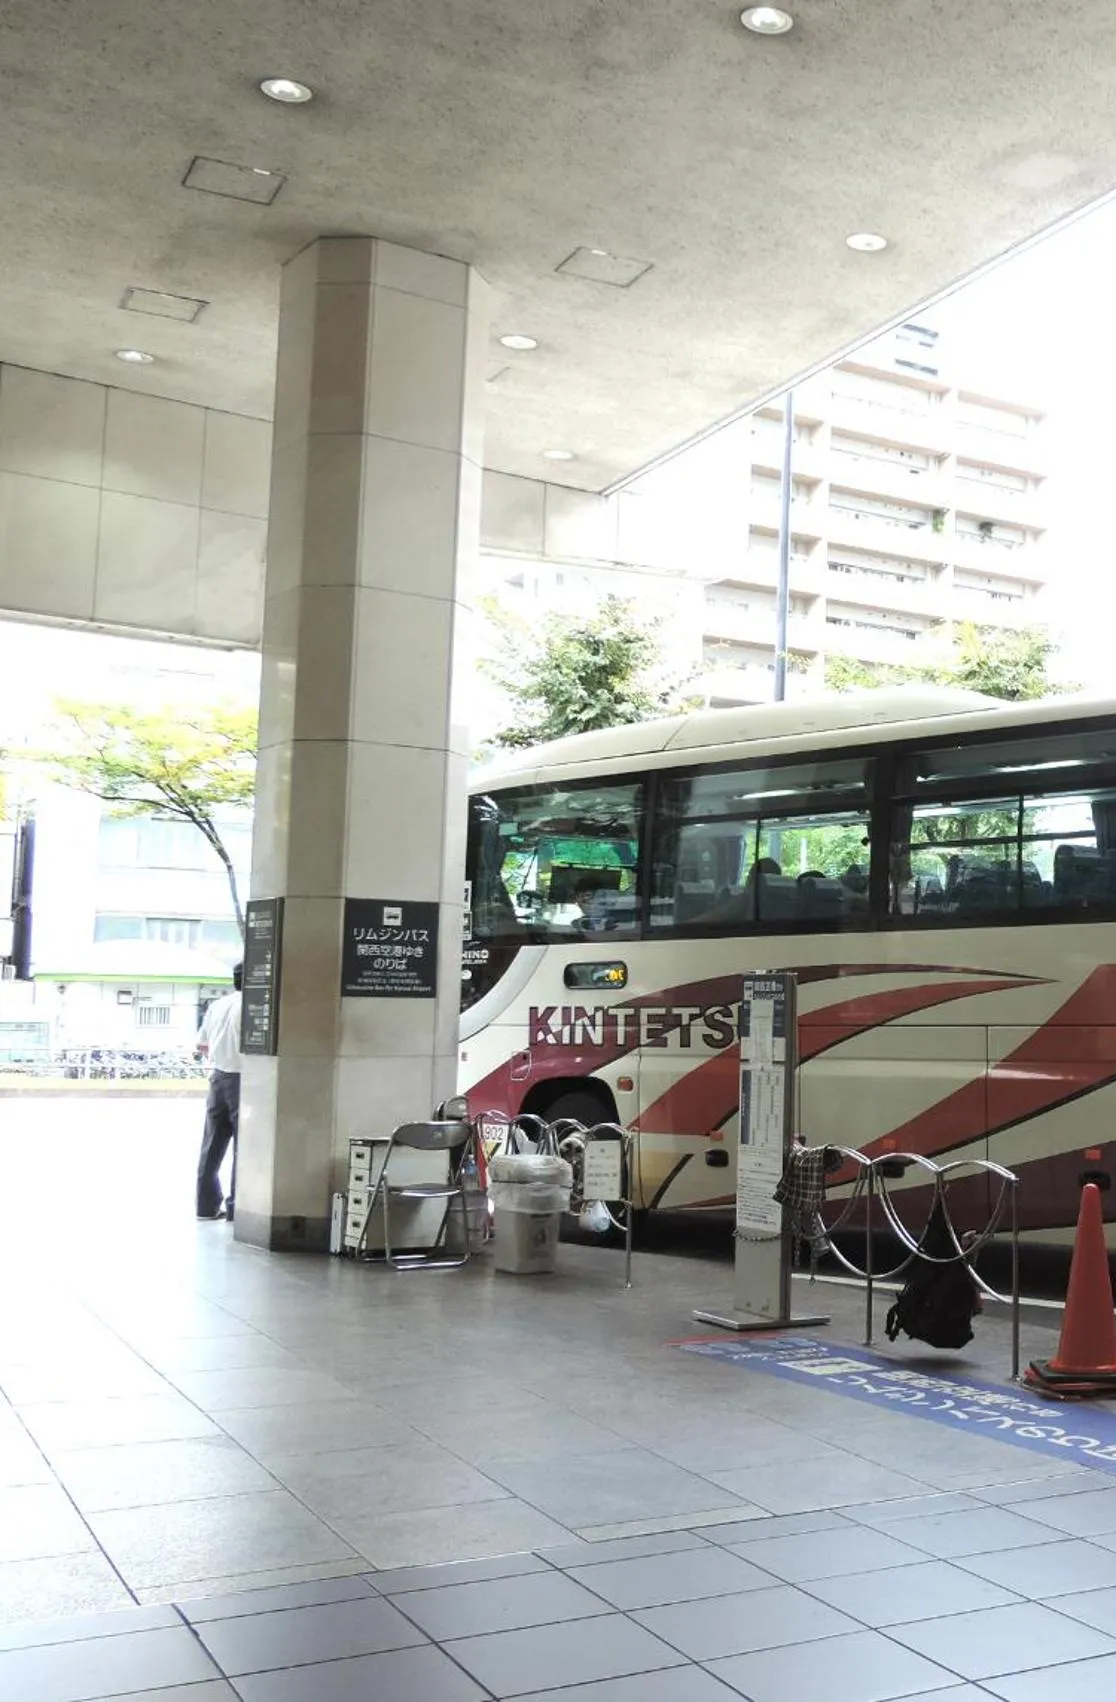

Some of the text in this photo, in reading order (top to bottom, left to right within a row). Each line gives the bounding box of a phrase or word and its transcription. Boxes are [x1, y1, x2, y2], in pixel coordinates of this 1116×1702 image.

[353, 927, 429, 942] リムジンバス
[356, 943, 424, 958] 関西空港ゆき
[373, 958, 408, 970] のりば
[529, 1006, 741, 1049] KINTETS
